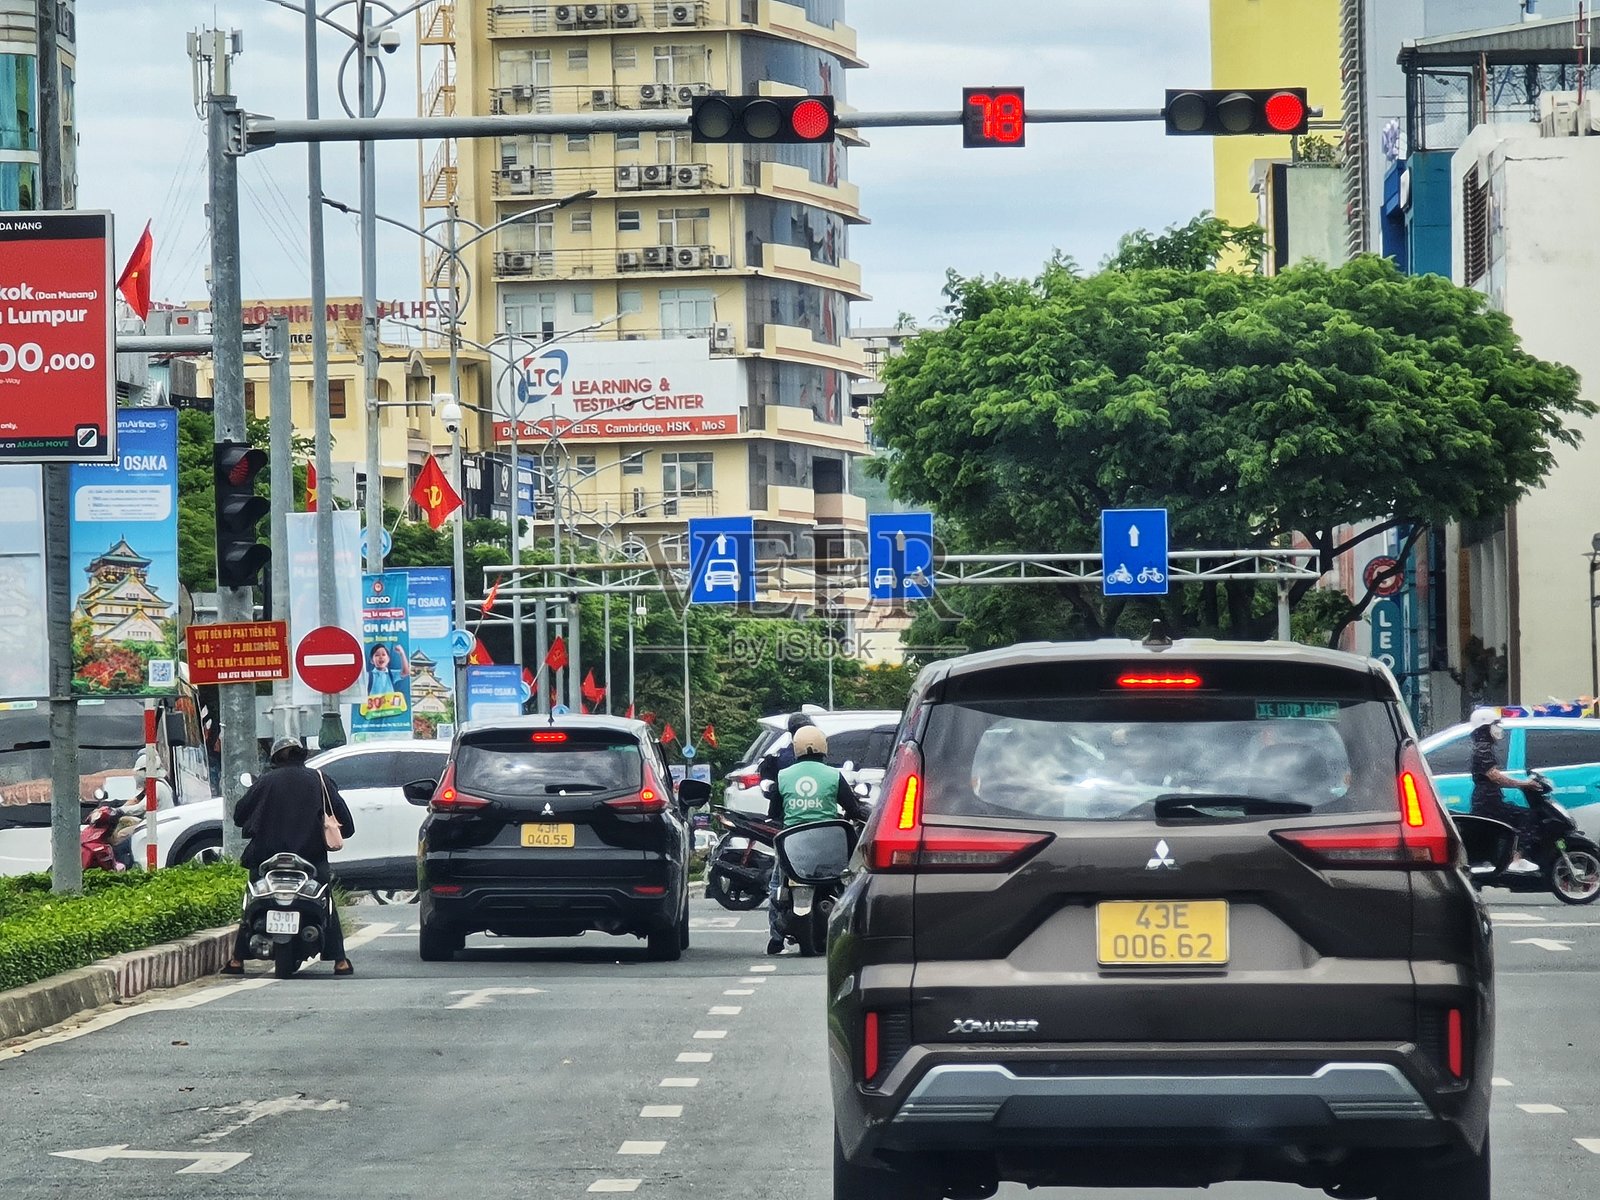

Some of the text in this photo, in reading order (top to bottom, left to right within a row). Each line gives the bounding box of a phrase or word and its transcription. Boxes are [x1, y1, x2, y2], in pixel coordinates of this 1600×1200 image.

[968, 94, 1023, 142] 78
[14, 221, 43, 230] NANG
[35, 292, 57, 300] (Don
[58, 289, 97, 300] Mueang)
[7, 307, 88, 327] Lumpur
[526, 368, 561, 388] LTC
[572, 376, 671, 396] LEARNING &
[573, 394, 705, 414] TESTING CENTER
[605, 420, 665, 435] Cambridge,
[701, 420, 727, 431] MoS
[17, 439, 45, 449] AirAsia
[45, 440, 70, 448] MOVE
[123, 455, 168, 471] OSAKA
[417, 597, 447, 608] OSAKA
[788, 797, 823, 811] gojek
[527, 834, 568, 846] 040.55
[1135, 903, 1189, 929] 43E
[1113, 933, 1213, 959] 006.62
